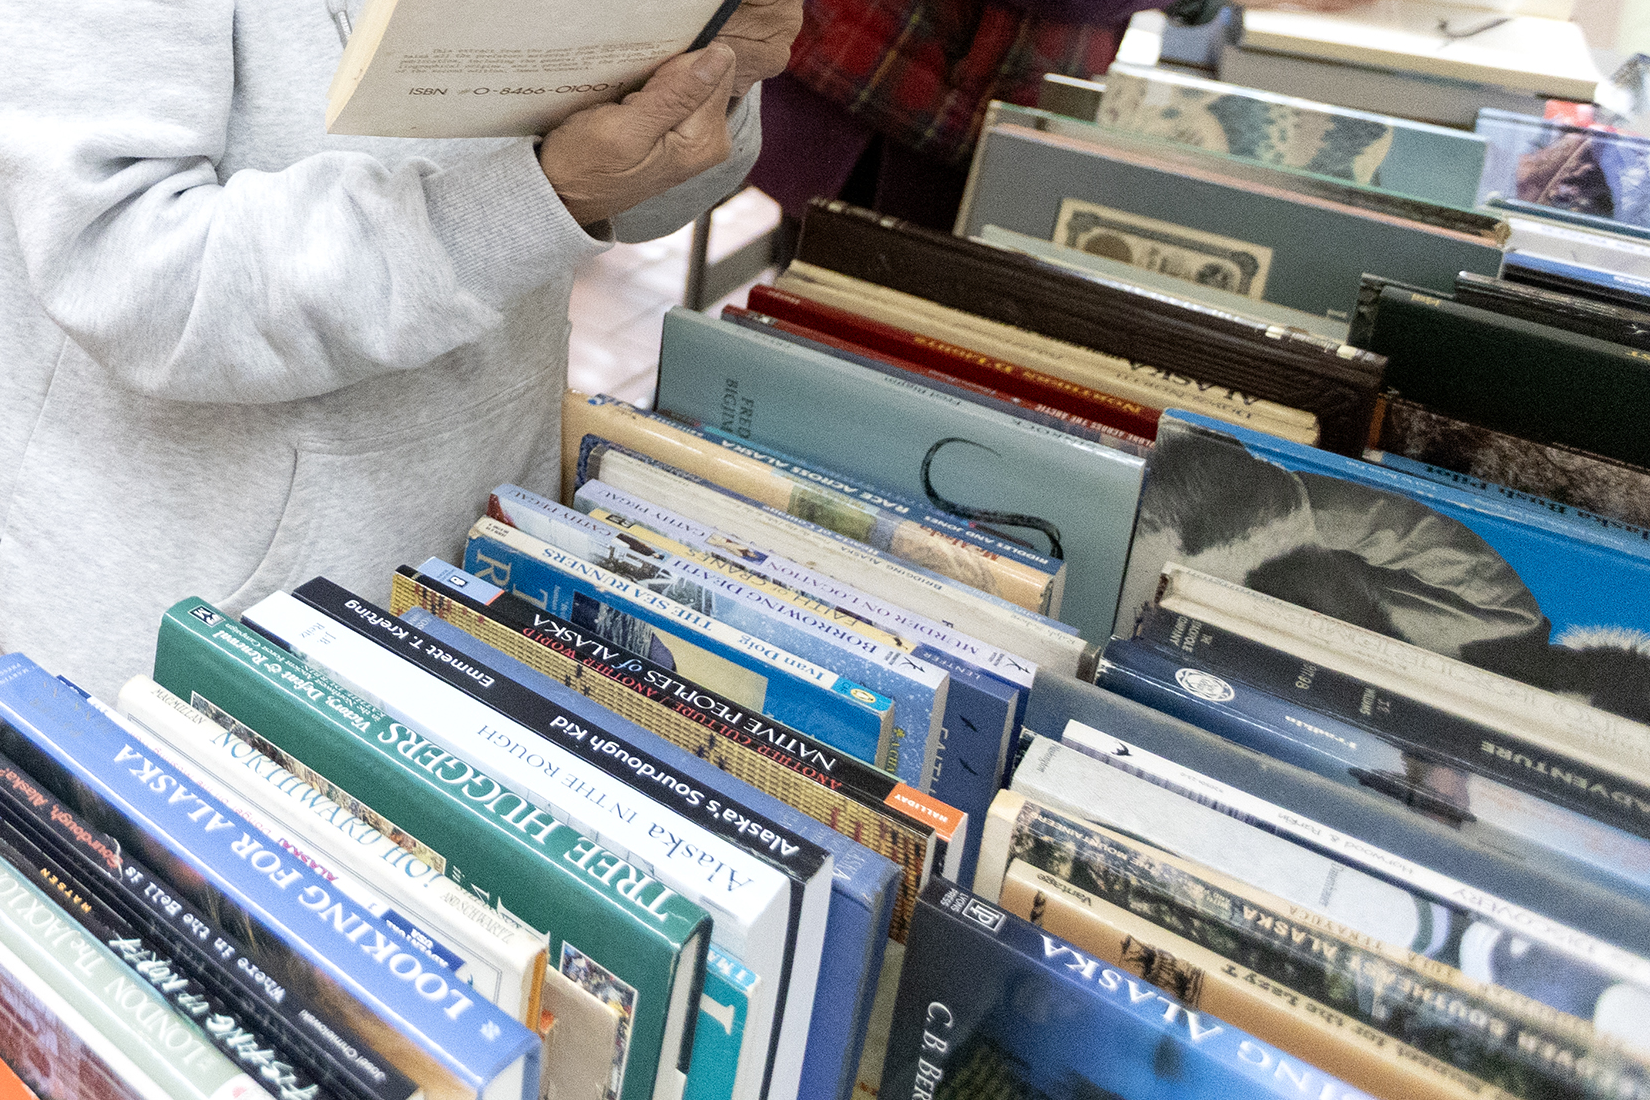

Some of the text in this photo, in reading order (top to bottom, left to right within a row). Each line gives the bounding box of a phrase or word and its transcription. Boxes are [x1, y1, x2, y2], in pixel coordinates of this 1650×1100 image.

[408, 87, 448, 96] ISBN
[737, 397, 755, 438] FRED
[1069, 414, 1088, 426] THE
[719, 438, 788, 470] ALASKA
[789, 463, 863, 497] ACROSS
[864, 490, 910, 514] RACE
[560, 508, 612, 538] CATHY
[653, 509, 707, 541] CATHY
[922, 513, 963, 534] JONES
[964, 528, 994, 545] AND
[540, 545, 629, 593] RUNNERS
[839, 545, 942, 590] BRIDGING ALASKA
[995, 540, 1049, 565] RIDDLES
[670, 555, 744, 596] DEATH
[765, 557, 861, 605] LOCATION
[628, 585, 669, 611] SEA
[669, 603, 714, 632] THE
[860, 598, 891, 618] ON
[223, 619, 262, 648] Campaign
[529, 611, 621, 666] ALASKA
[744, 585, 879, 655] BORROWING
[895, 612, 980, 656] MURDER
[259, 643, 286, 663] Forest
[520, 623, 579, 659] WORLD
[736, 632, 780, 661] Doig
[211, 625, 373, 733] Victory, Defeat & Renewal
[580, 653, 660, 699] ANOTHER
[616, 651, 646, 678] of
[781, 654, 825, 682] Ivan
[921, 649, 982, 680] LENTFER
[313, 676, 356, 706] Northwest
[355, 703, 371, 717] the
[642, 666, 744, 726] PEOPLES
[340, 595, 800, 860] Alaska's Sourdough Kid Emmett T. Krefting
[369, 711, 382, 723] in
[669, 697, 753, 746] CULTURE
[741, 715, 837, 771] NATIVE
[110, 740, 234, 841] ALASKA
[149, 685, 206, 728] MACMILLAN
[209, 725, 383, 852] NORTHWARD
[379, 840, 444, 893] HO!
[374, 714, 562, 845] HUGGERS
[474, 720, 754, 900] Alaska IN THE ROUGH
[894, 793, 949, 823] HALLIDAY
[44, 801, 125, 871] Sourdough,
[119, 863, 144, 887] is
[224, 826, 303, 893] FOR
[562, 832, 682, 922] TREE
[37, 865, 93, 914] MATSEN
[140, 880, 183, 918] Hell
[1033, 870, 1093, 907] Vantage
[18, 895, 80, 953] JACK
[178, 910, 213, 942] the
[1238, 903, 1340, 960] ALASKA
[61, 933, 107, 979] The
[208, 934, 236, 961] in
[294, 878, 475, 1023] LOOKING
[232, 953, 289, 1004] Where
[1032, 933, 1224, 1050] ALASKA
[101, 970, 208, 1067] LONDON
[921, 1001, 953, 1053] C. B.
